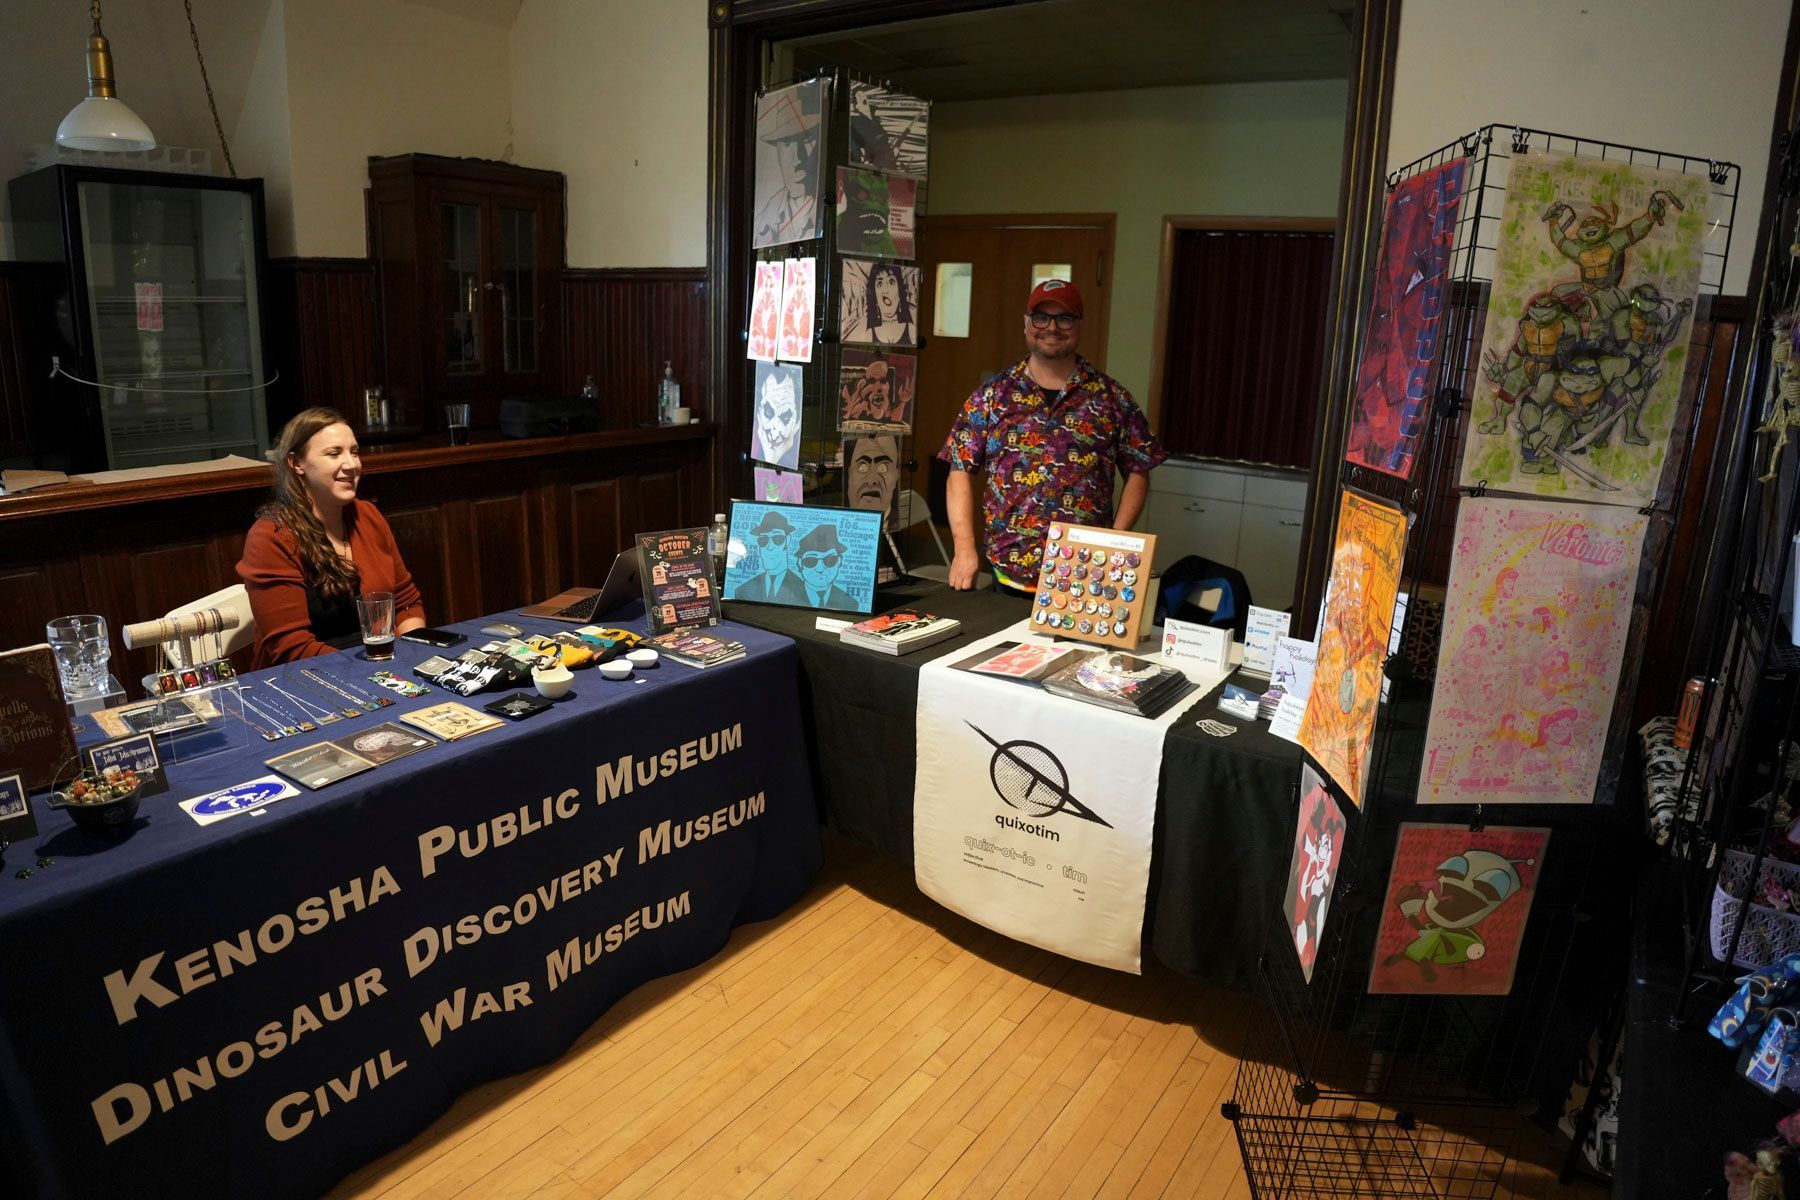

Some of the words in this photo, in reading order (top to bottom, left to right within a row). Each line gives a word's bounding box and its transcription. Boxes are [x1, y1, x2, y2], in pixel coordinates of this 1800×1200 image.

[838, 529, 876, 541] Chicago,
[1540, 520, 1627, 566] Veronica
[658, 540, 691, 552] OCTOBER
[1251, 643, 1268, 651] PayPal
[1279, 639, 1302, 654] happy
[231, 784, 257, 793] Lakes
[995, 814, 1060, 842] quixotim
[103, 865, 401, 1025] KENOSHA
[418, 788, 581, 879] PUBLIC
[596, 722, 743, 805] MUSEUM
[1062, 864, 1088, 884] tim
[1072, 887, 1086, 895] noun
[91, 967, 389, 1146] DINOSAUR
[403, 847, 624, 978] DISCOVERY
[638, 791, 765, 864] MUSEUM
[265, 1049, 408, 1142] CIVIL
[419, 987, 534, 1048] WAR
[546, 891, 691, 991] MUSEUM
